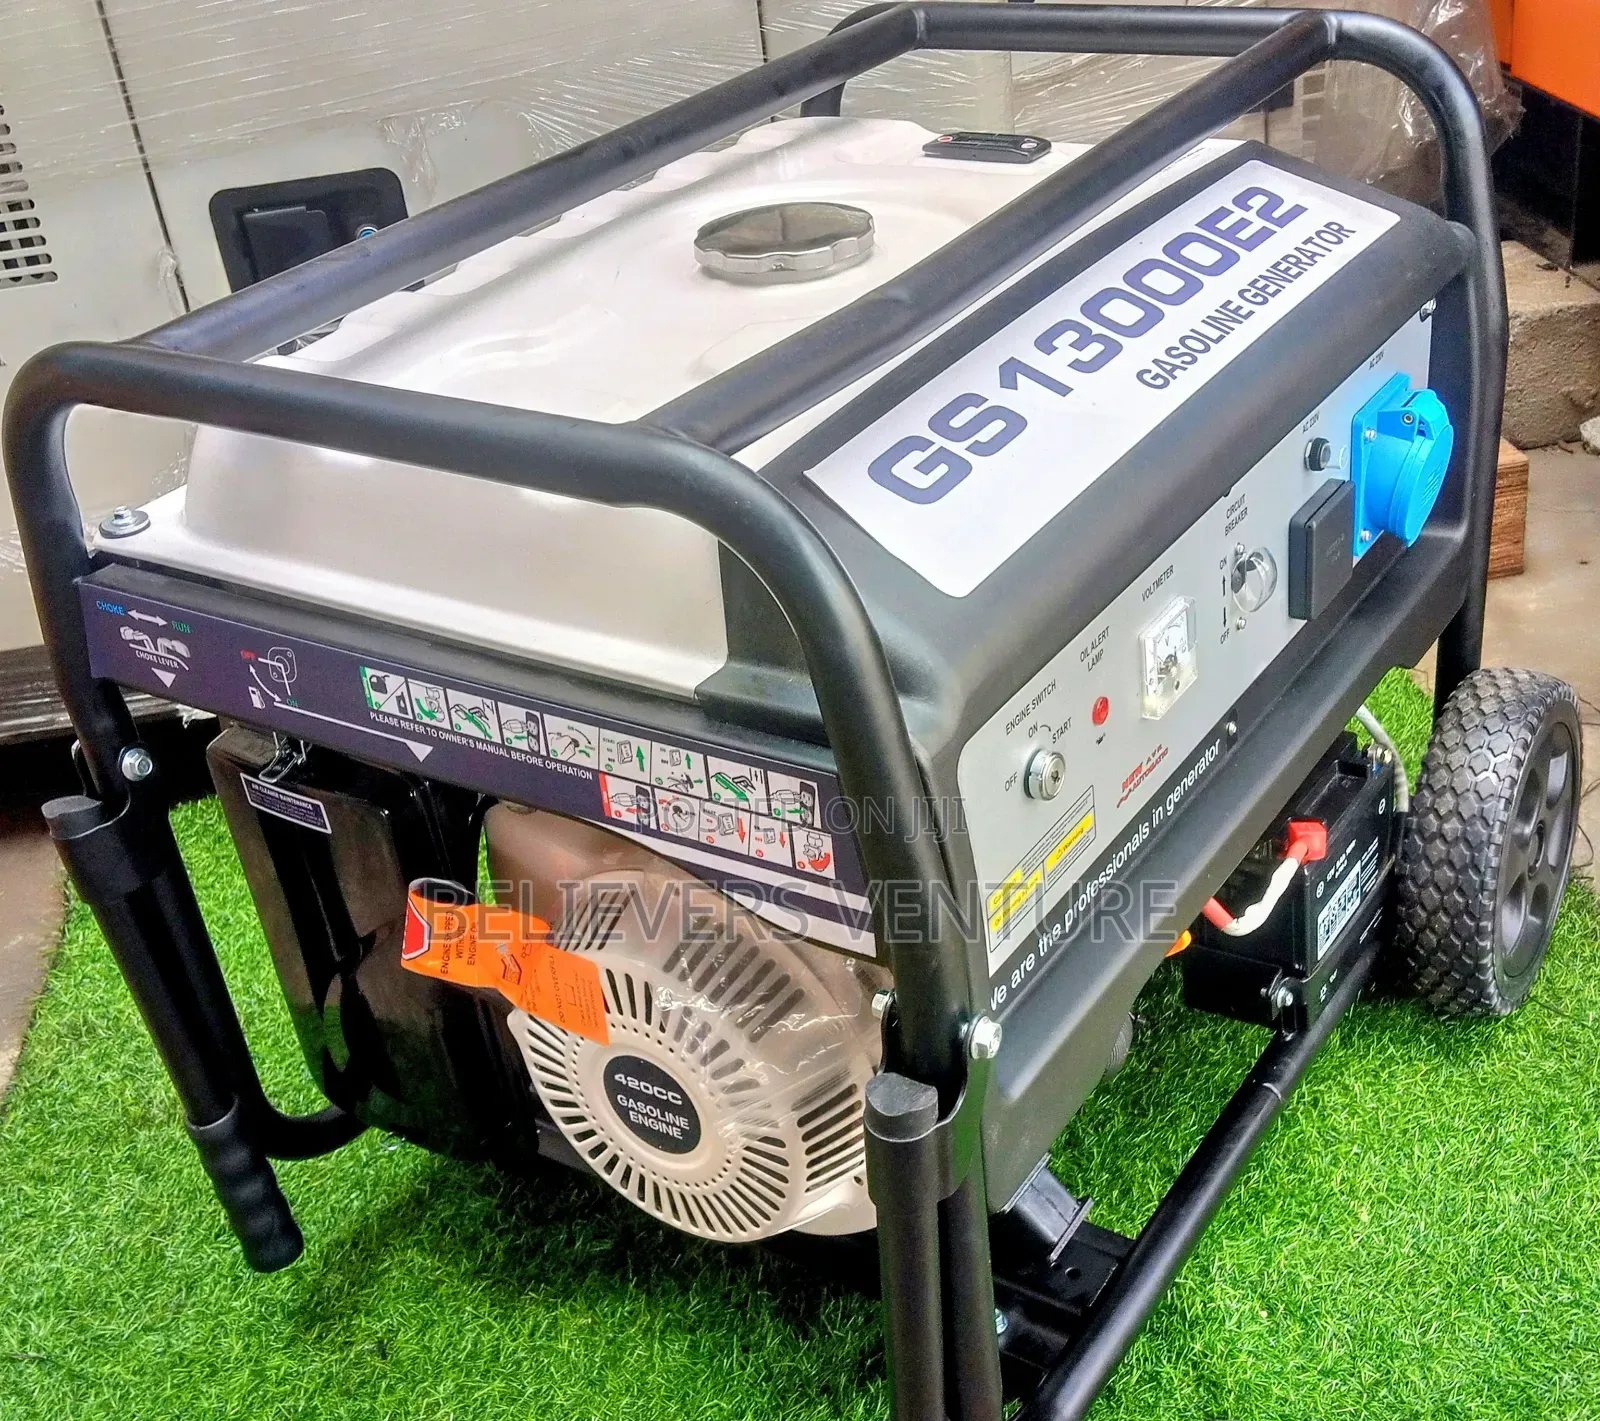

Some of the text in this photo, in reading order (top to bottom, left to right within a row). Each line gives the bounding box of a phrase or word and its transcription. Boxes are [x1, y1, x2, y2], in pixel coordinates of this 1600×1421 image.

[1136, 221, 1357, 390] GASOLINE GENERATOR
[868, 186, 1309, 505] GS13000E2
[1224, 507, 1248, 536] BREAKER
[1226, 493, 1246, 519] CIRCUIT
[1219, 556, 1227, 570] ON
[1141, 564, 1174, 602] VOLTMETER
[96, 600, 191, 633] CHOKE RUN
[1079, 626, 1110, 663] OIL ALERT
[1220, 628, 1230, 644] OFF
[135, 650, 179, 669] CHOKE LEVER
[1087, 648, 1104, 672] LAMP
[286, 698, 299, 708] ON
[1005, 679, 1057, 735] ENGINE SWITCH
[369, 711, 593, 780] PLEASE REFER TO OWNER'S MANUAL BEFORE OPERATION
[1028, 717, 1072, 744] ON START
[1004, 771, 1018, 792] OFF
[1011, 953, 1035, 989] are
[1038, 923, 1062, 957] the
[1064, 820, 1150, 933] professionals
[1152, 805, 1164, 828] in
[1166, 738, 1221, 816] generator
[440, 943, 452, 974] ENGINE
[467, 934, 477, 966] ENGINE
[614, 1073, 683, 1106] 420CC
[617, 1094, 690, 1130] GASOLINE
[628, 1110, 683, 1140] ENGINE
